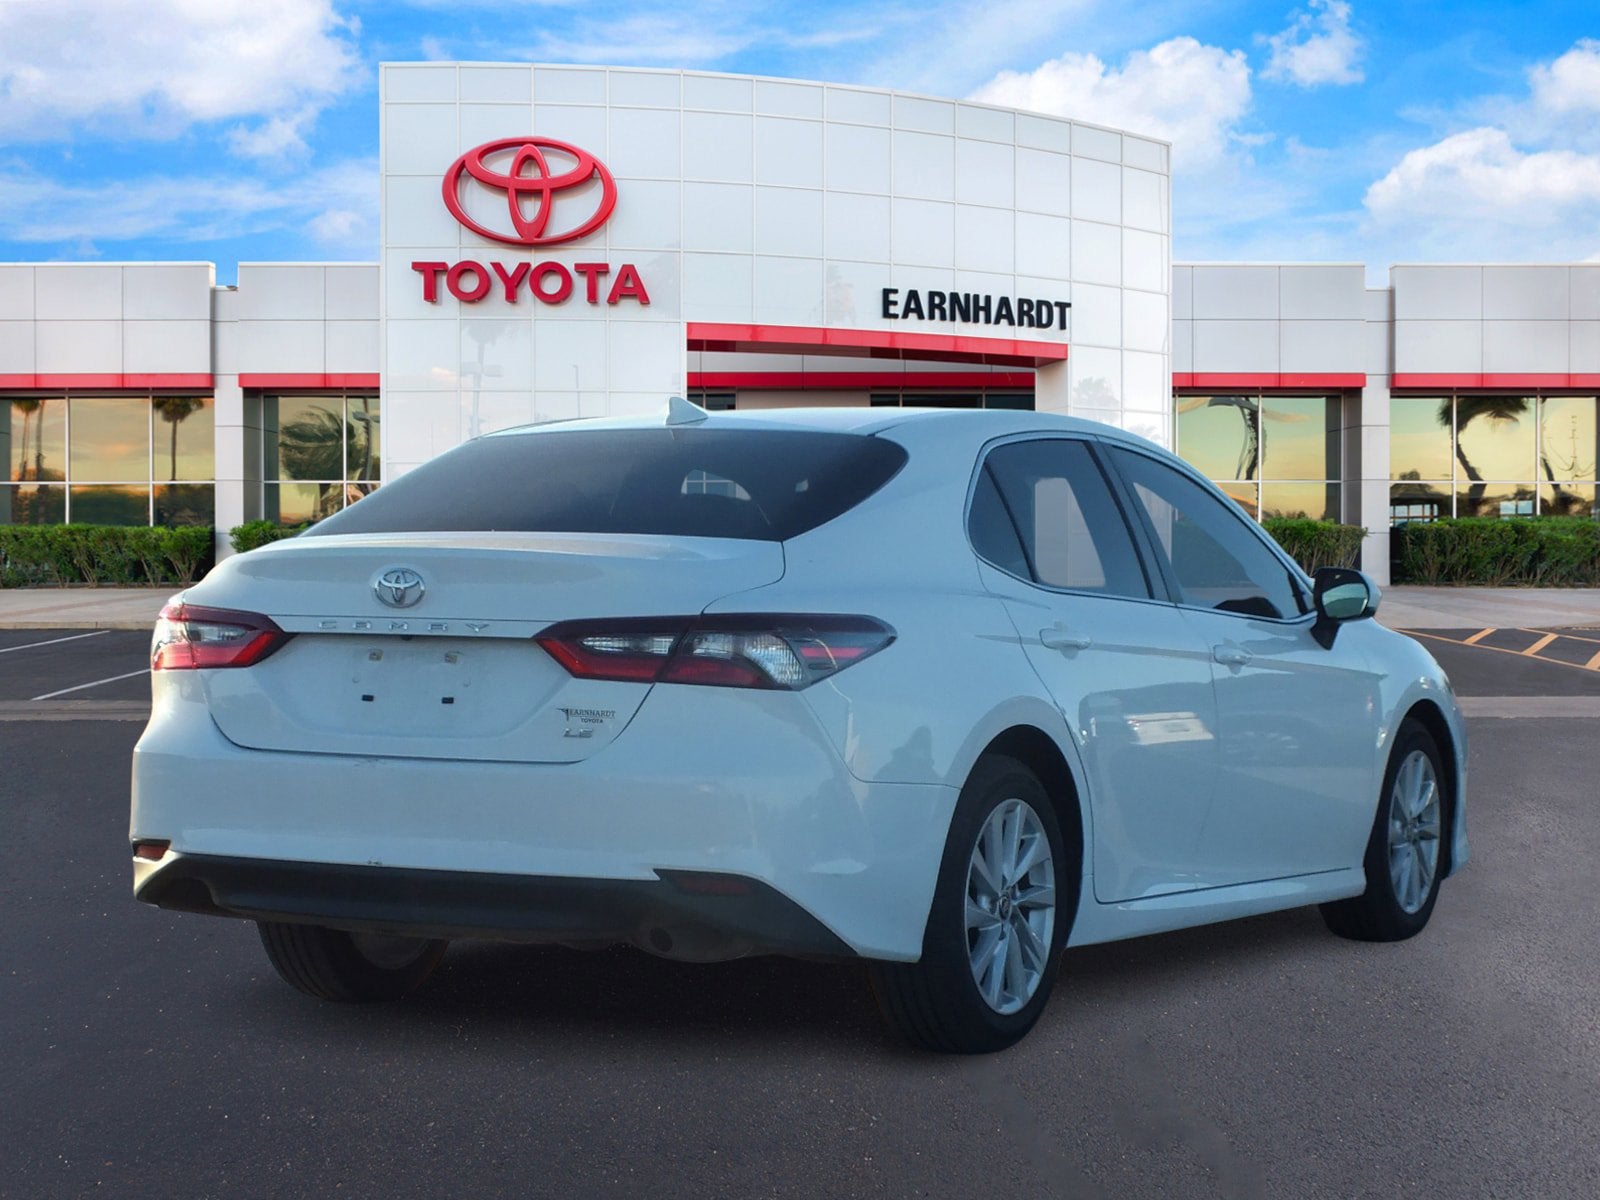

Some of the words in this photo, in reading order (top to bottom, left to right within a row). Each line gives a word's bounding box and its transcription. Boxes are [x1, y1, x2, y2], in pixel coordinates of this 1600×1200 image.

[411, 260, 650, 304] TOYOTA
[882, 288, 1072, 330] EARNHARDT
[318, 620, 490, 632] CAMRY
[564, 728, 593, 738] LE
